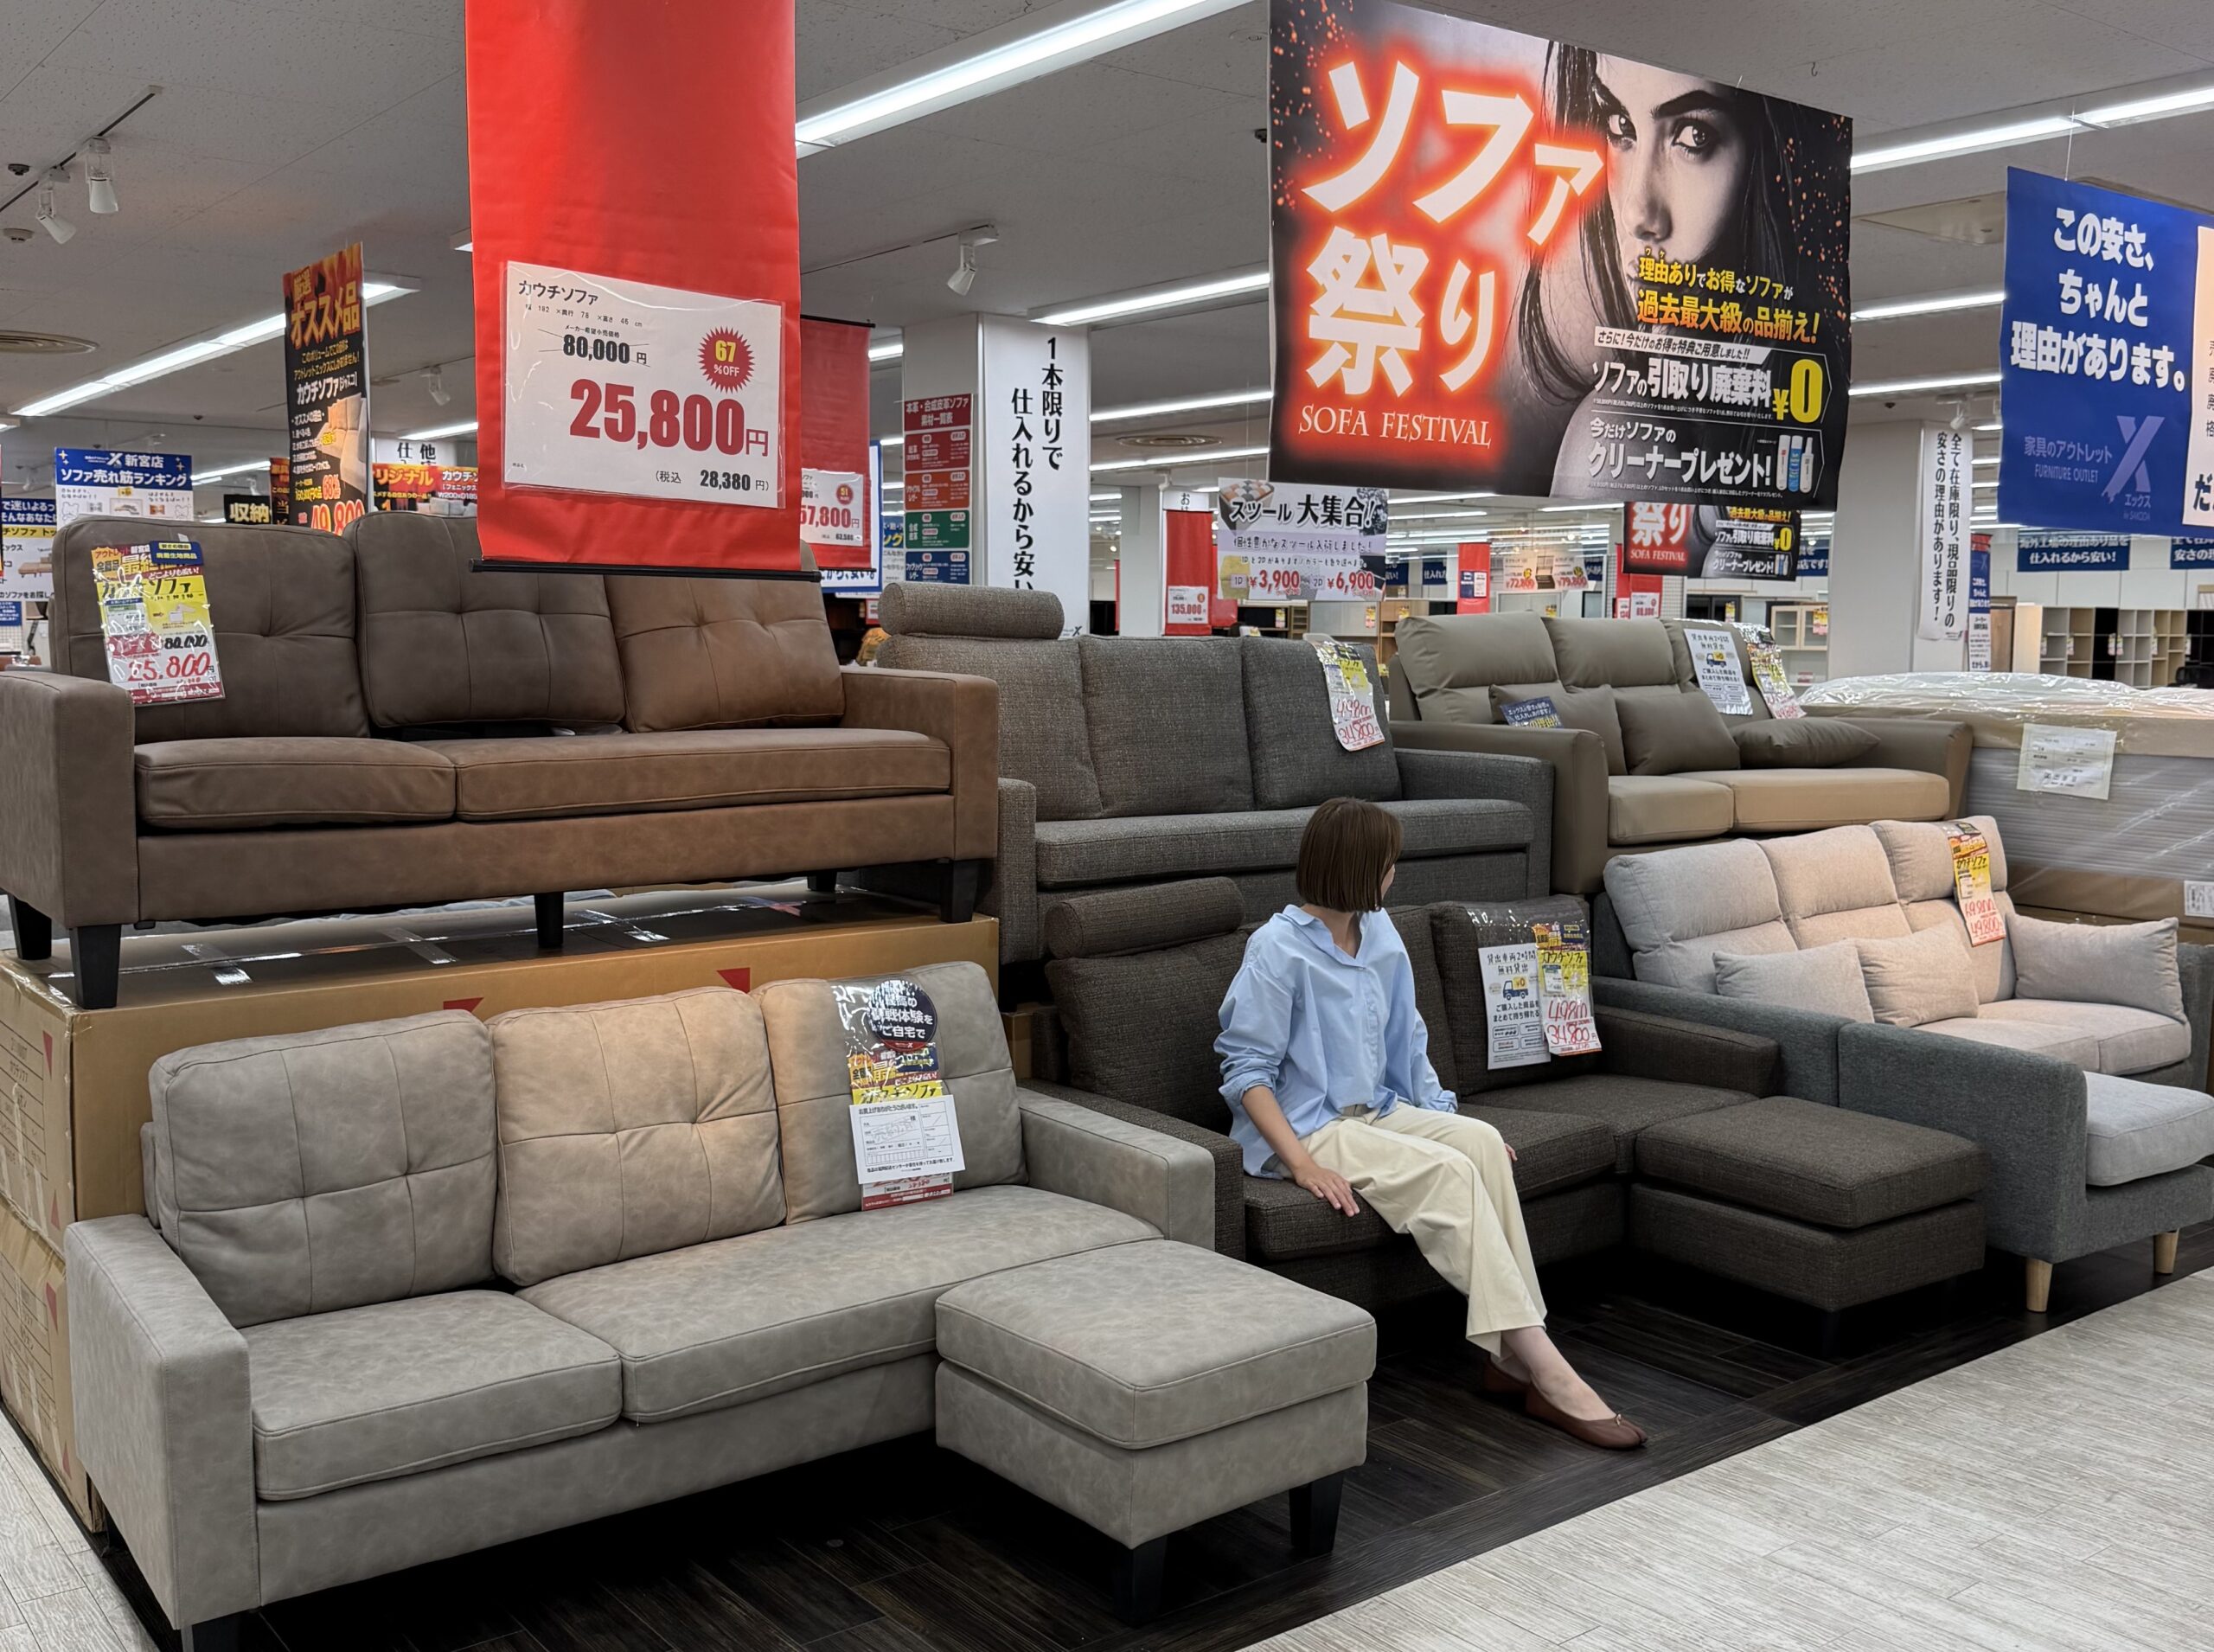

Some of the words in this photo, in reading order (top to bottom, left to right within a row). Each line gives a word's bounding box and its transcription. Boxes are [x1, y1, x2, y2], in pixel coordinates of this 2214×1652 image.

[1301, 60, 1605, 247] ソファ
[2053, 207, 2154, 272] この安さ、
[518, 279, 599, 306] カウチソファ
[1639, 257, 1794, 301] 理由ありでお得なソファが
[1306, 224, 1496, 398] 祭り
[2058, 269, 2148, 327] ちゃんと
[290, 280, 361, 350] オススメ品
[1637, 290, 1820, 344] 過去最大級の品揃え!
[563, 334, 630, 364] 80,000
[637, 352, 648, 364] 円
[714, 339, 737, 362] 67
[2011, 320, 2186, 394] 理由があります。
[713, 363, 740, 378] %OFF
[297, 377, 339, 406] カウチソファ
[1042, 337, 1064, 471] 1本限りで
[1593, 358, 1772, 408] ソファの引取り廃棄料
[1773, 359, 1823, 423] ¥0
[570, 378, 745, 457] 25,800
[745, 428, 769, 458] 円
[1298, 403, 1370, 438] SOFA
[1379, 411, 1492, 448] FESTIVAL
[1590, 417, 1676, 443] 今だけソファの
[125, 454, 164, 469] 新宮店
[2024, 435, 2113, 464] 家具のアウトレット
[61, 468, 187, 487] ソファ売れ筋ランキング
[373, 468, 434, 486] リジナル
[1588, 441, 1771, 488] クリーナープレゼント!
[2035, 464, 2071, 481] FURNITURE
[2073, 467, 2099, 484] OUTLET
[655, 470, 682, 485] (税込
[700, 469, 751, 492] 28,380
[755, 478, 770, 492] 円)
[2193, 474, 2214, 511] だ
[229, 503, 270, 523] 収納
[1181, 492, 1191, 511] お
[1230, 499, 1293, 522] スツール
[1297, 494, 1375, 529] 大集合!
[2124, 493, 2152, 509] エックス
[1631, 501, 1687, 547] 祭り
[1932, 431, 1948, 622] 安さの理由があります!
[1944, 432, 1962, 629] 全て在庫限り、現品限りの
[1629, 547, 1650, 560] SOFA
[1652, 550, 1686, 562] FESTIVAL
[2029, 551, 2117, 565] 仕入れるから安い!
[1250, 569, 1301, 594] ¥3,900
[1327, 571, 1374, 594] ¥6,900
[1488, 950, 1536, 966] 貸出車両2時間
[1498, 963, 1528, 976] 無料貸出
[882, 1022, 926, 1039] ご自宅で
